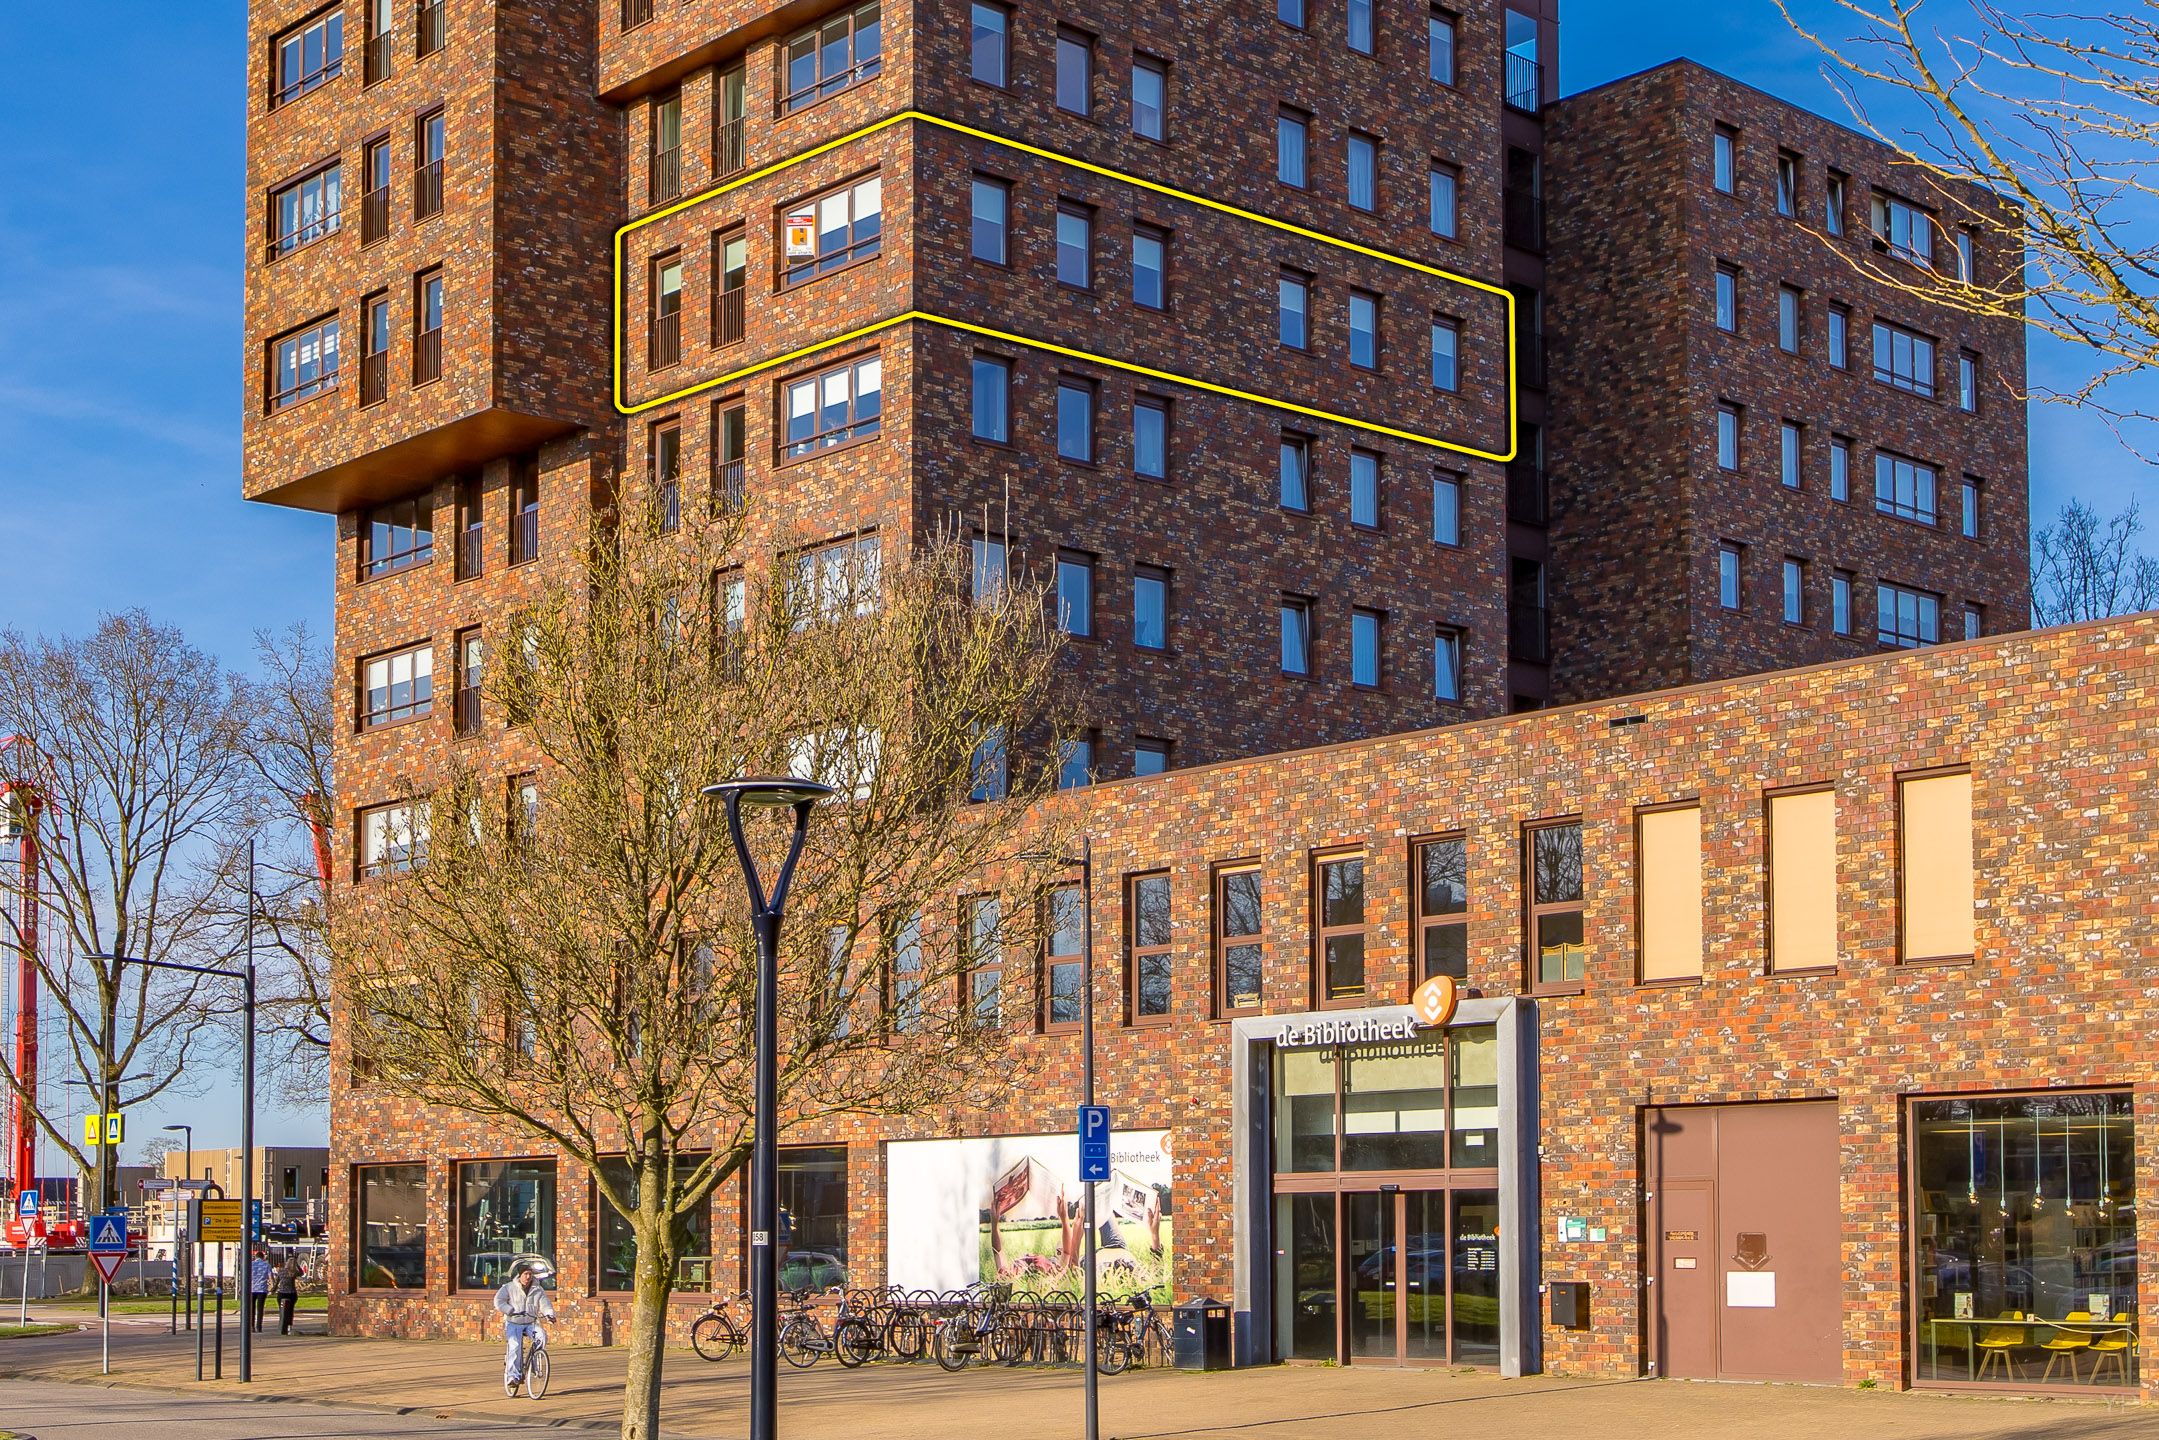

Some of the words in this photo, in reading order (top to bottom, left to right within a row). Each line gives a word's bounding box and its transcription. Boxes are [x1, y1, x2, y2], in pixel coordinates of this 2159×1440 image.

[1276, 1024, 1299, 1047] de
[1304, 1015, 1416, 1045] Bibliotheek
[1087, 1110, 1103, 1138] P
[1110, 1151, 1161, 1164] Bibliotheek
